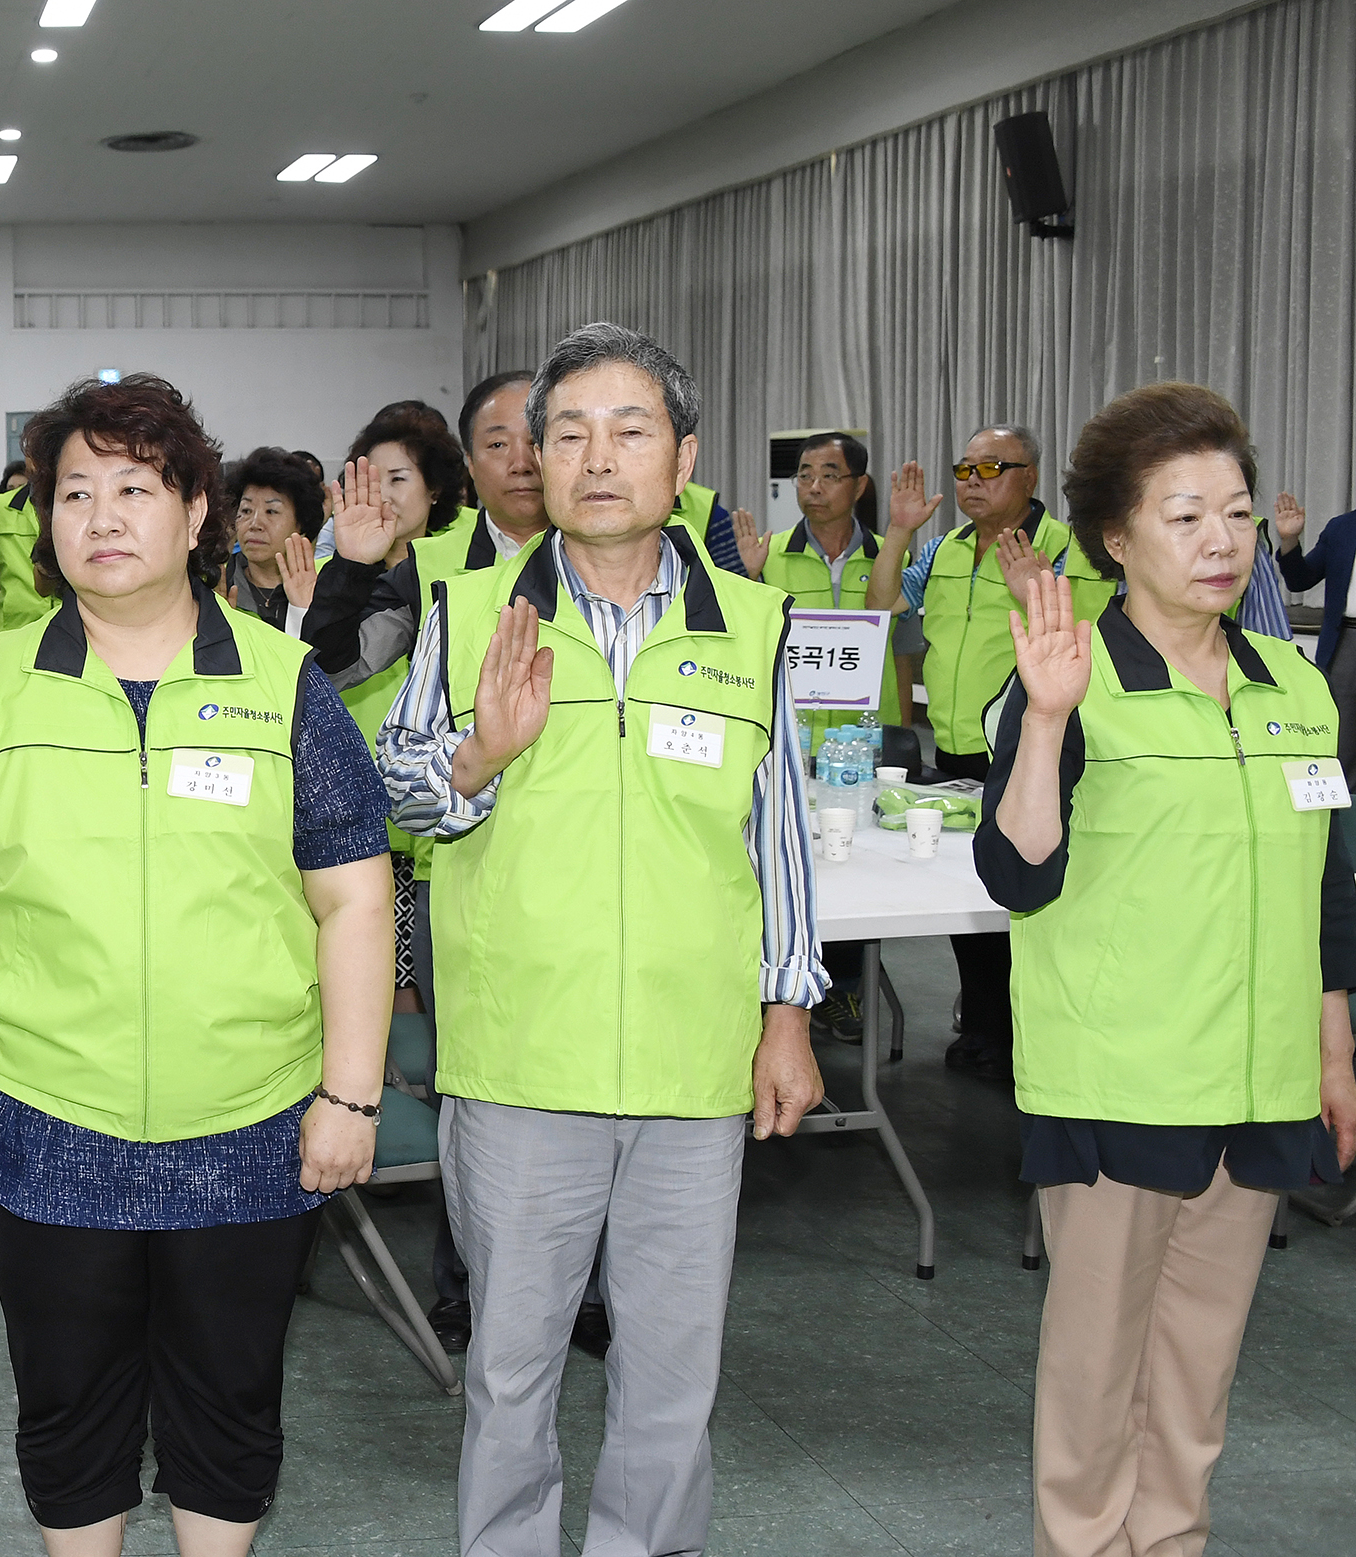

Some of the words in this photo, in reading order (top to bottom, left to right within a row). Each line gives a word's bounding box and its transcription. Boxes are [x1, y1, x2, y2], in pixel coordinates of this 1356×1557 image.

[786, 645, 861, 671] 중곡1동
[700, 665, 756, 690] 주민자율청소봉사단
[222, 706, 284, 725] 주민자율청소봉사단
